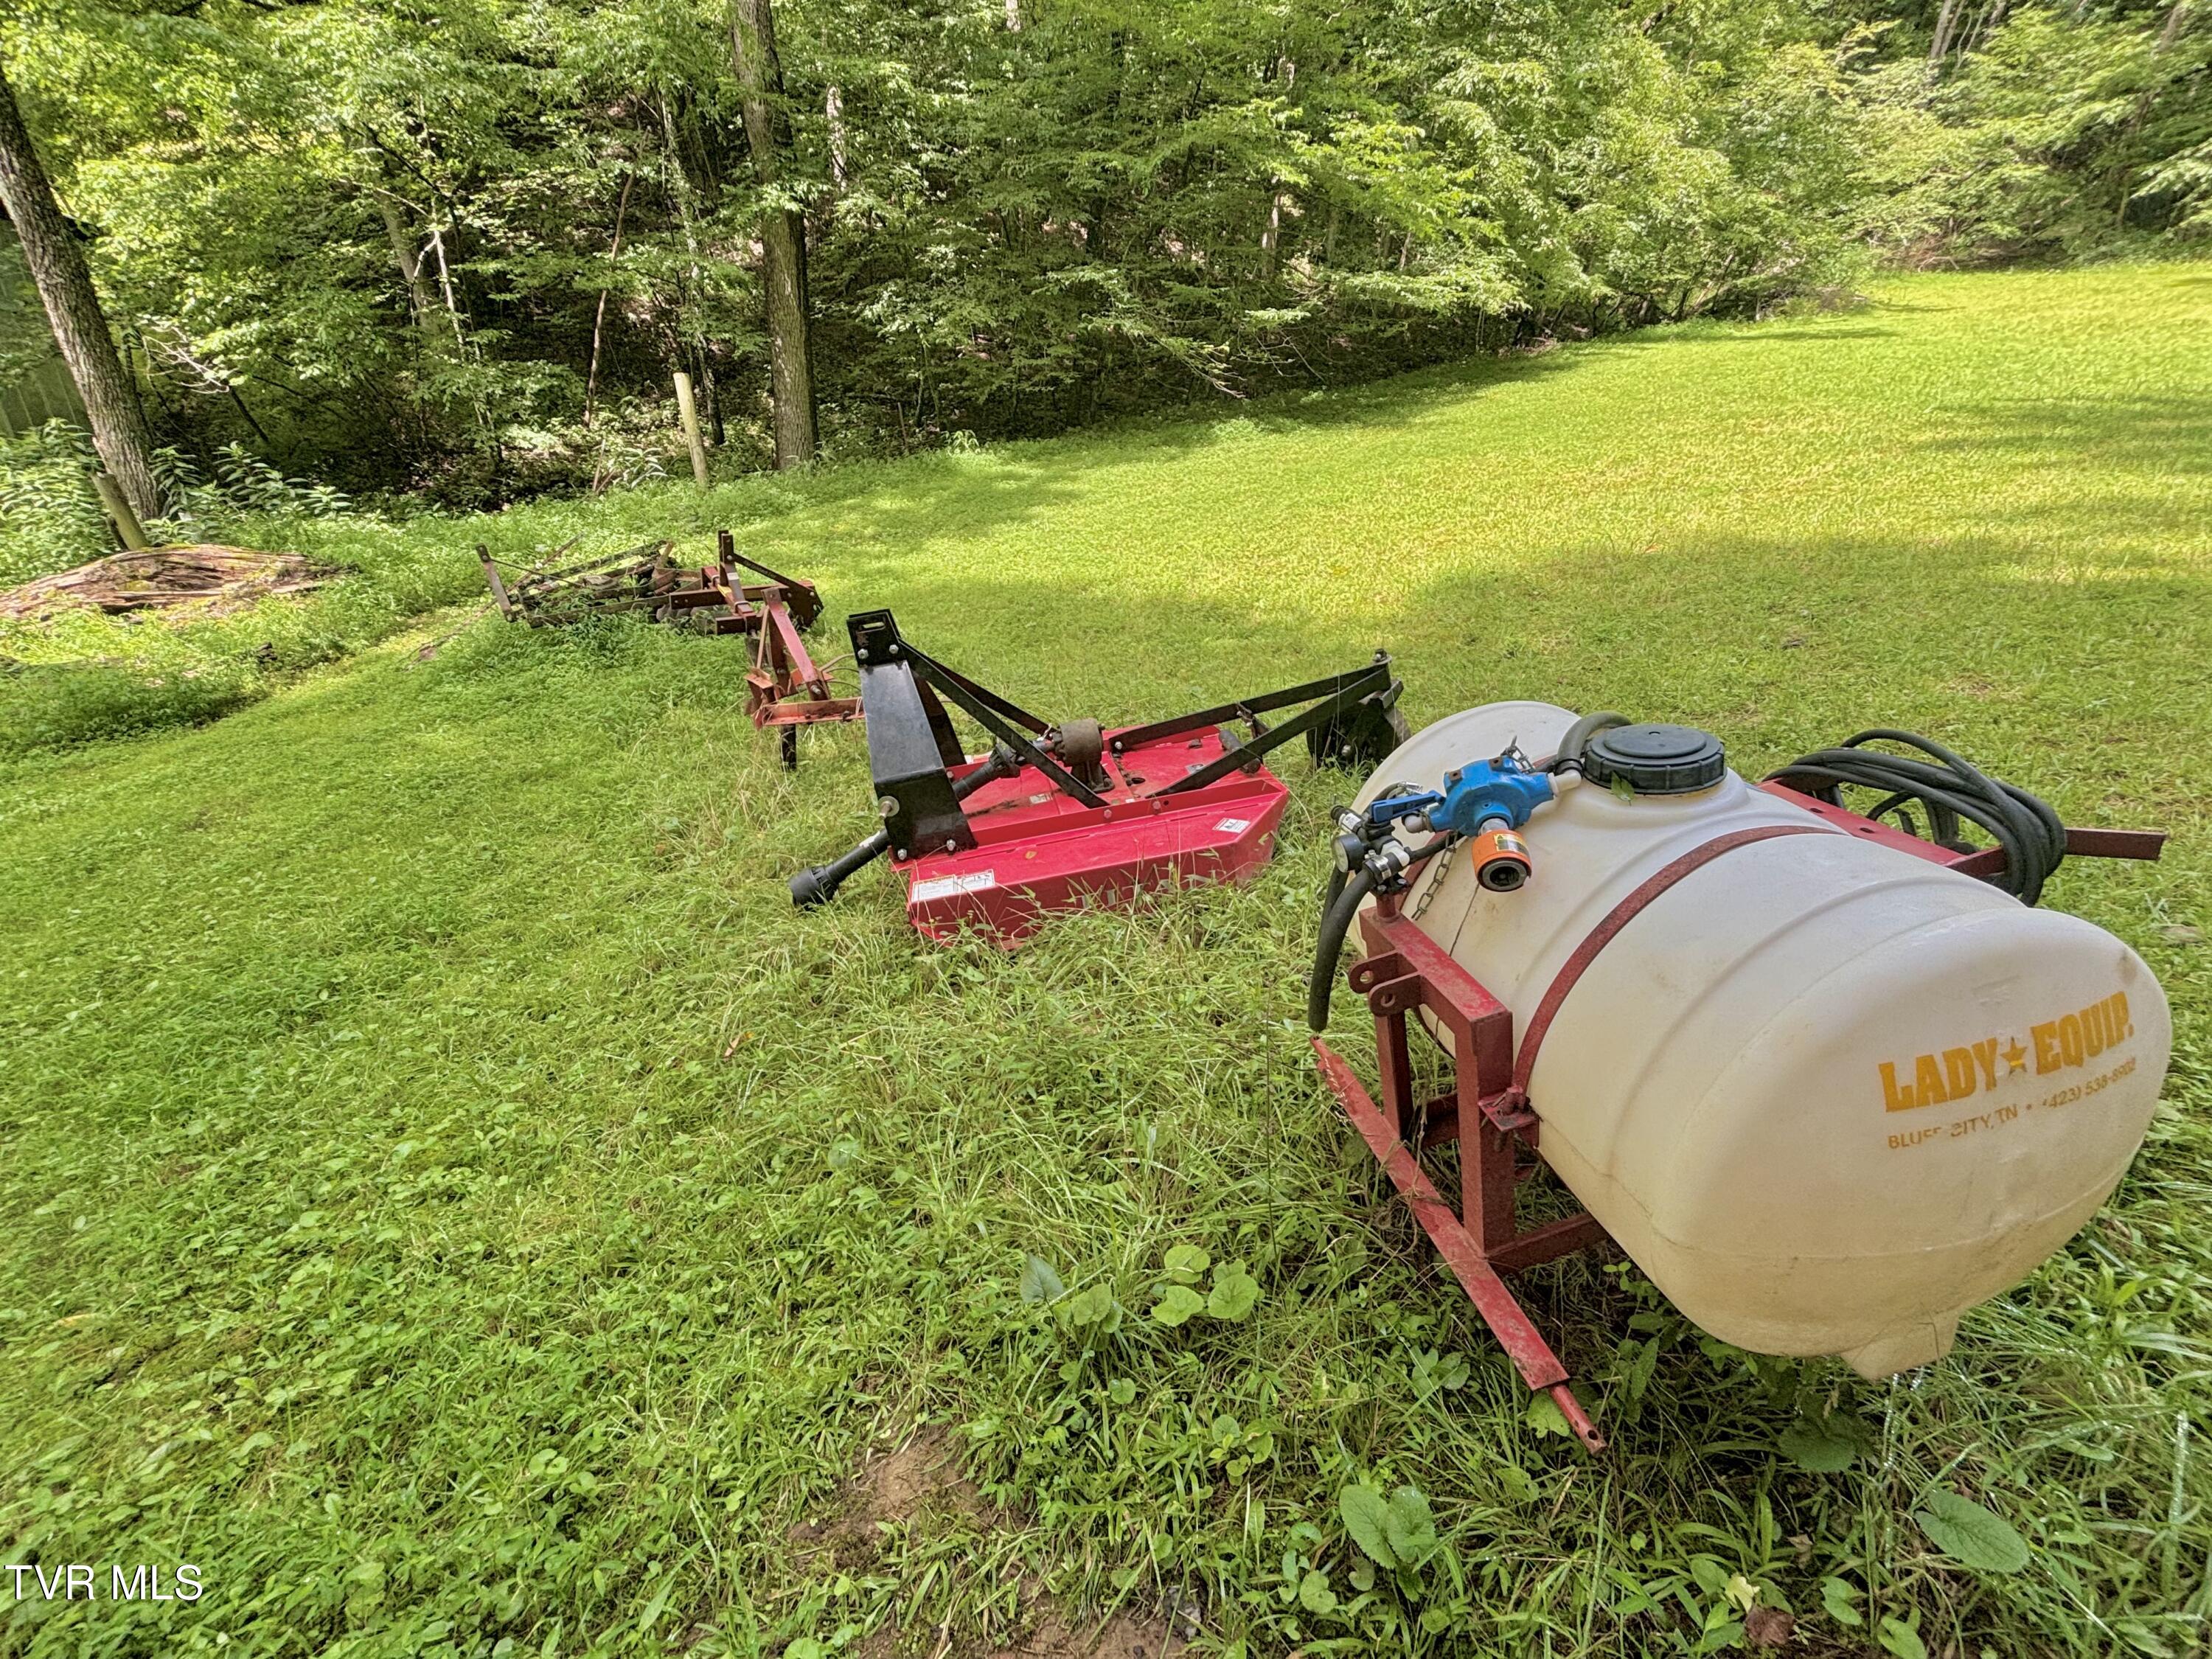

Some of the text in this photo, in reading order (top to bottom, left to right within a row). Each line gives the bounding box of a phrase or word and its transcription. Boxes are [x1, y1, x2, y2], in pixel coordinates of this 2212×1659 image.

[1879, 991, 2135, 1112] LADY EQUIP.
[1995, 1104, 2018, 1123] TN
